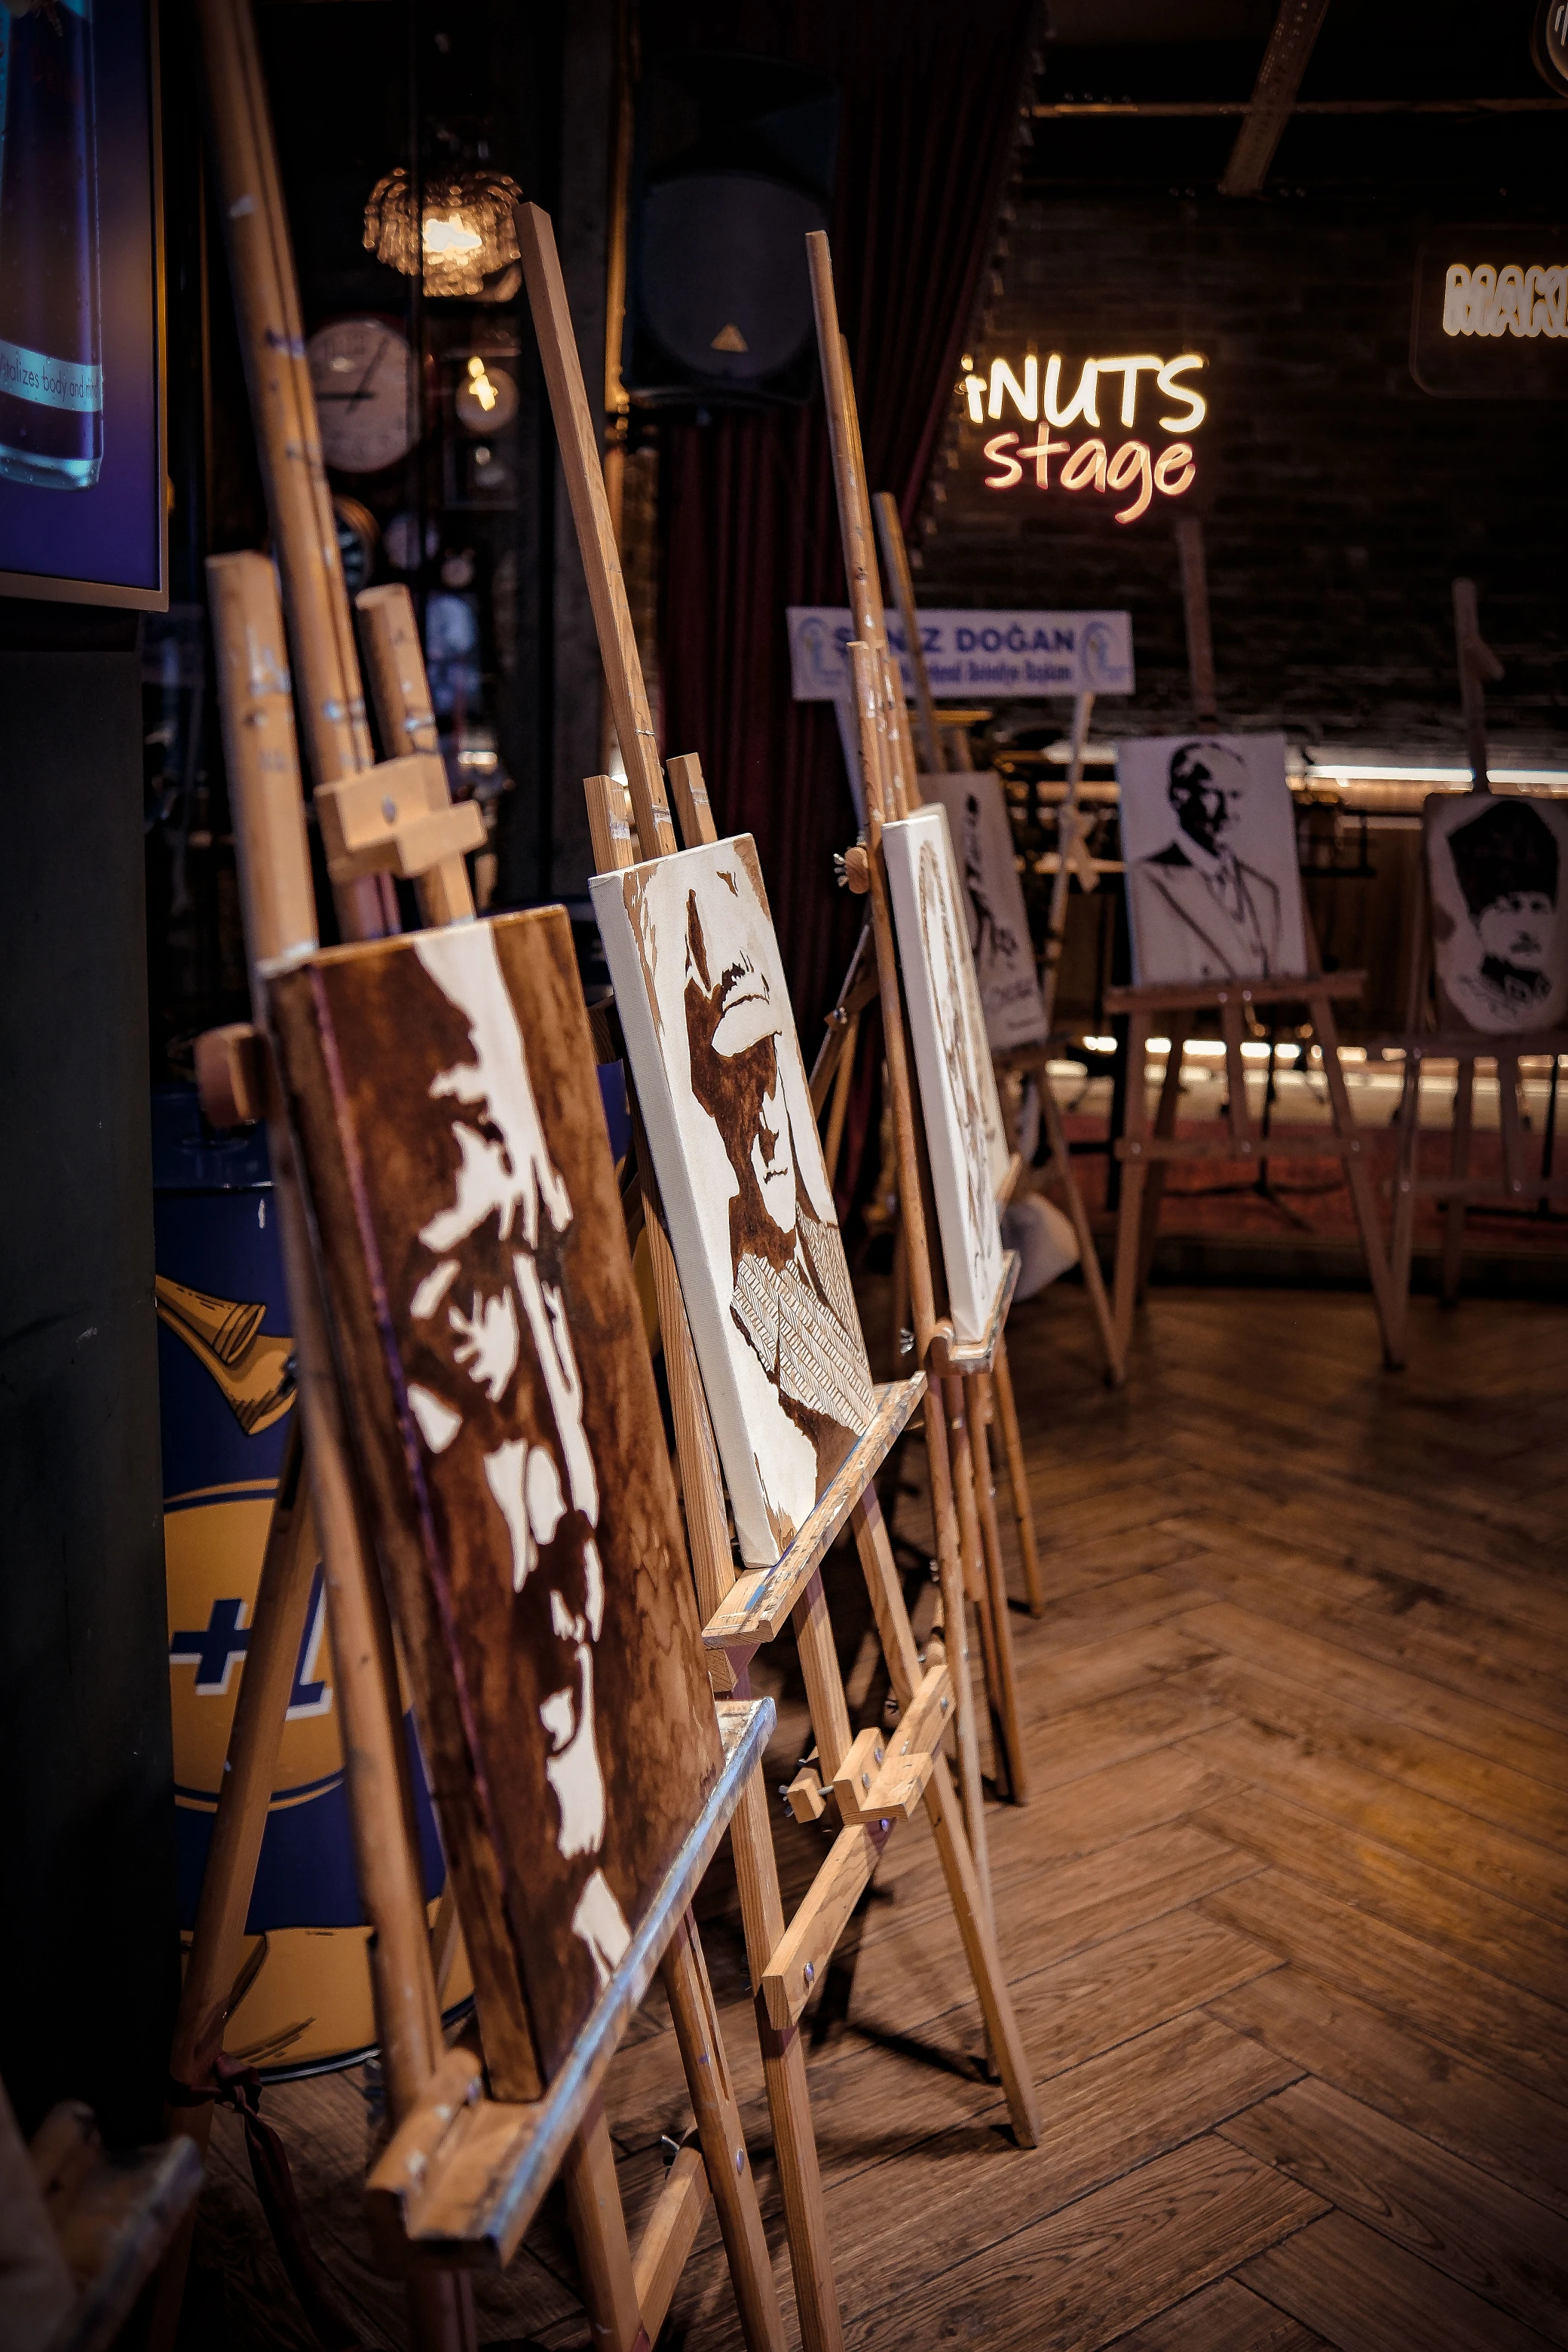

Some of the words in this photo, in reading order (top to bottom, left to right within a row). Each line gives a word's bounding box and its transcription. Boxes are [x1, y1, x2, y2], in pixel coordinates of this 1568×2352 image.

[41, 366, 67, 403] body
[69, 375, 84, 398] and
[960, 353, 1206, 433] iNUTS
[982, 421, 1197, 525] stage
